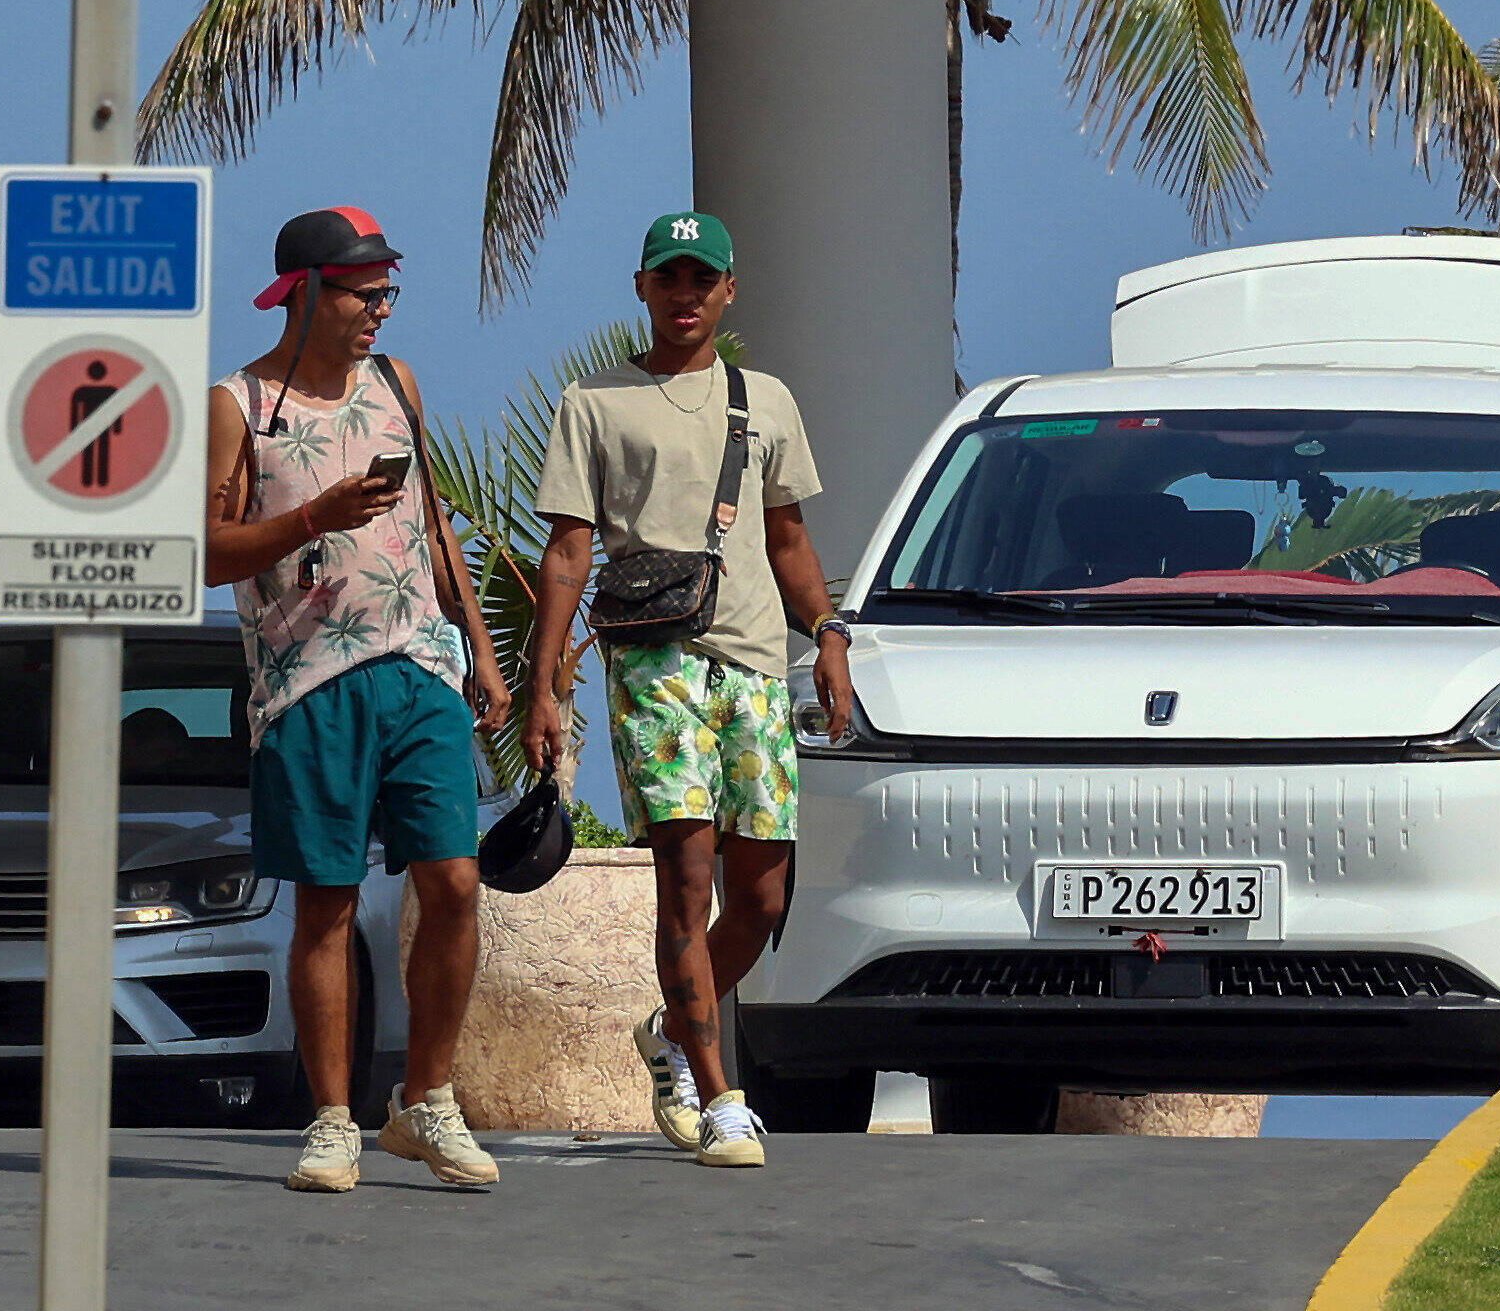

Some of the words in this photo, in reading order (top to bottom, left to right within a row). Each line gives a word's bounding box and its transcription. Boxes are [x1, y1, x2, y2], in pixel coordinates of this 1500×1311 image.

[51, 194, 142, 234] EXIT
[27, 255, 176, 297] SALIDA
[33, 542, 155, 559] SLIPPERY
[53, 565, 136, 581] FLOOR
[3, 592, 183, 610] RESBALADIZO
[1063, 874, 1071, 911] CUBA
